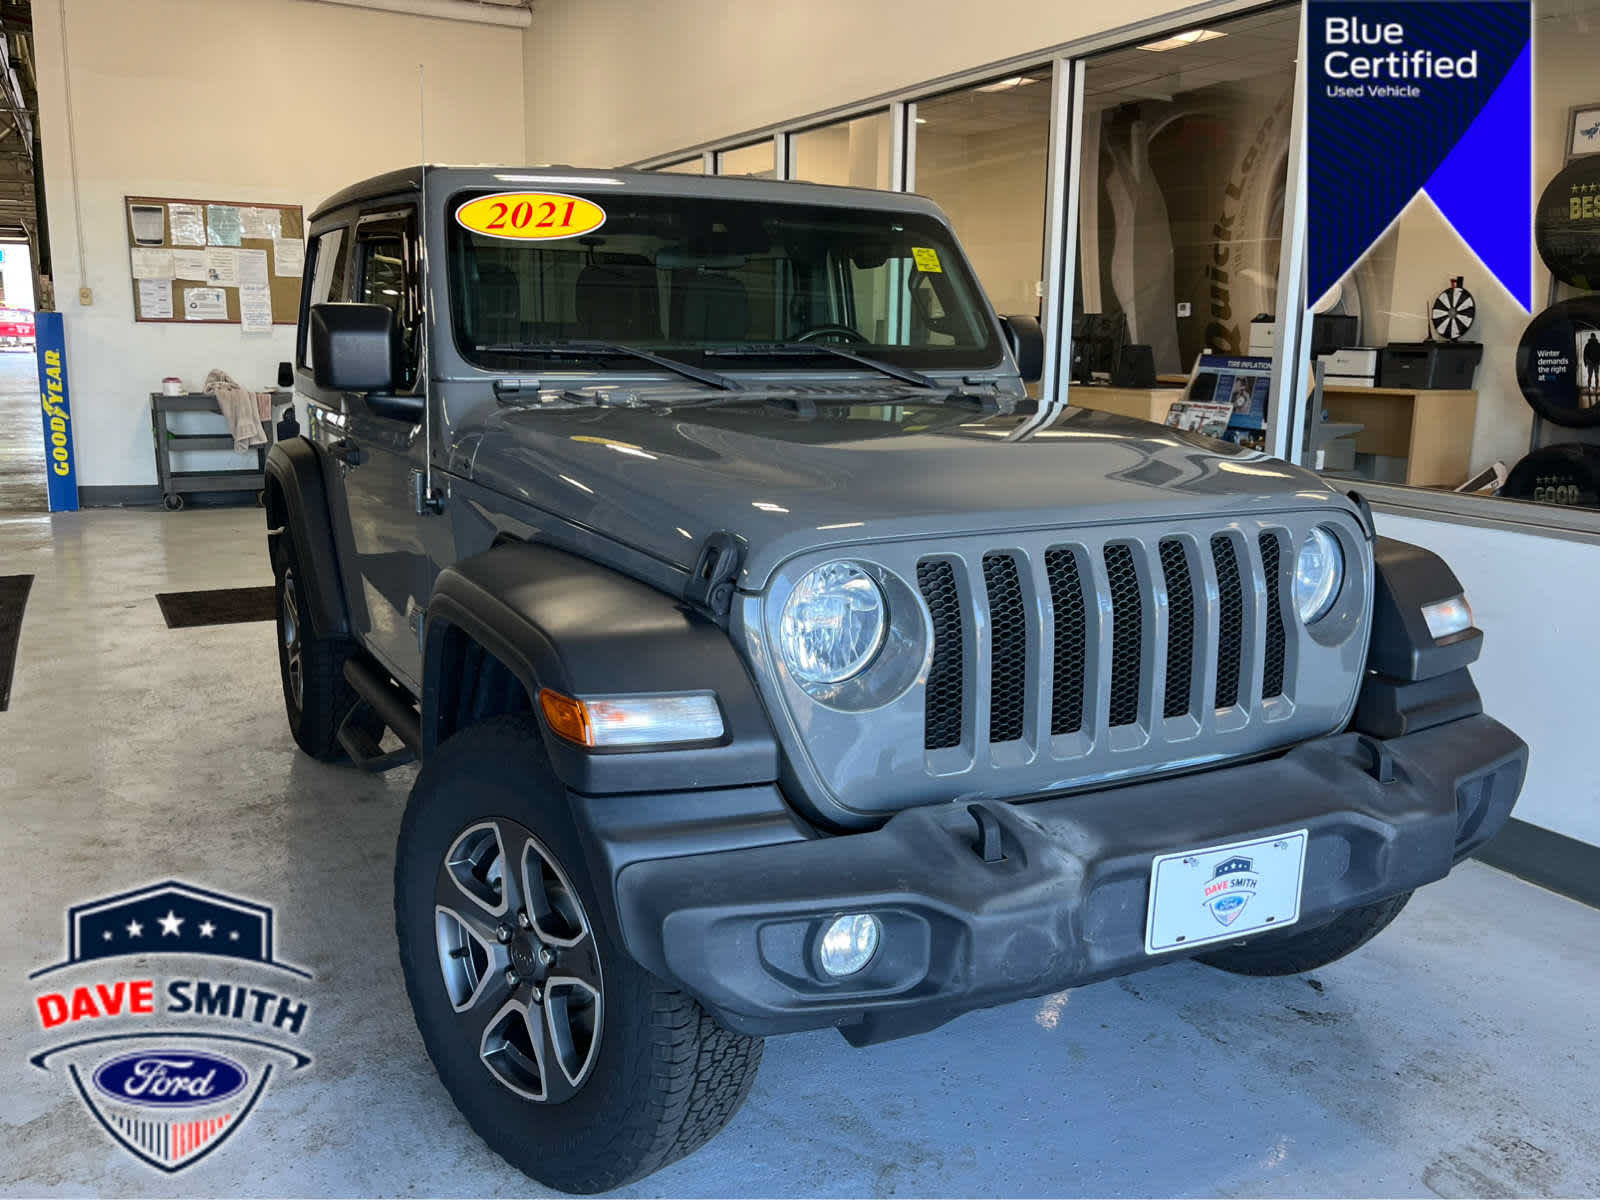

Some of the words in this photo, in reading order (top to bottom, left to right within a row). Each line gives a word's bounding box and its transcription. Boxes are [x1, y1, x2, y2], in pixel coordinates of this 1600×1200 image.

[486, 201, 575, 229] 2021
[1537, 358, 1569, 366] demands
[1537, 366, 1550, 374] the
[1551, 365, 1567, 375] right
[42, 350, 70, 476] GOODYEAR
[1205, 880, 1228, 896] DAVE
[1230, 878, 1257, 889] SMITH
